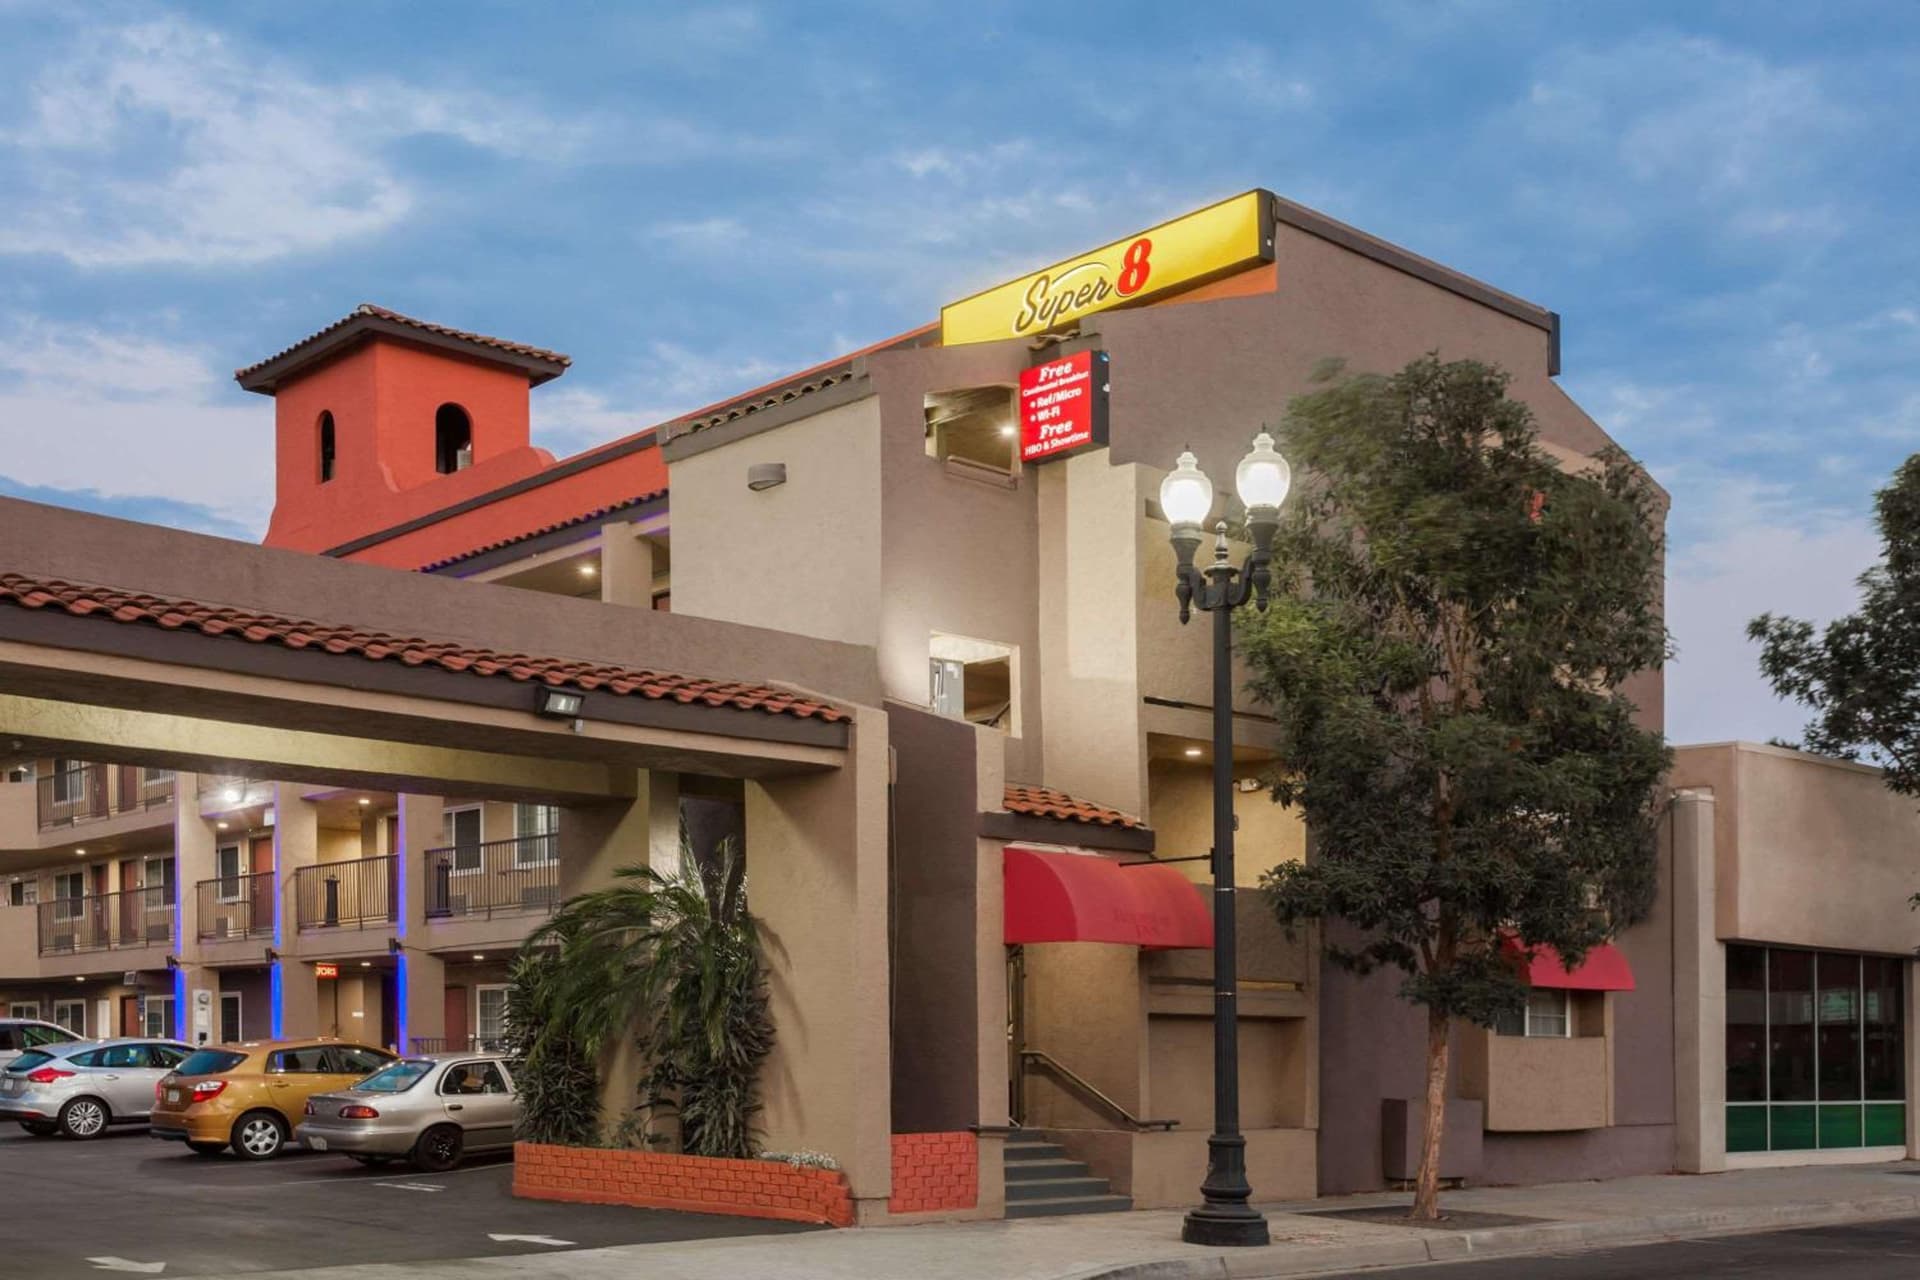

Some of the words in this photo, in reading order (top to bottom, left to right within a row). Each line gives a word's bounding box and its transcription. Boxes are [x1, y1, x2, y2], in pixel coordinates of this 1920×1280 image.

[1013, 273, 1113, 333] Super
[1115, 238, 1153, 297] 8
[1039, 362, 1072, 382] Free
[1039, 420, 1073, 440] Free
[1025, 442, 1042, 456] HBO
